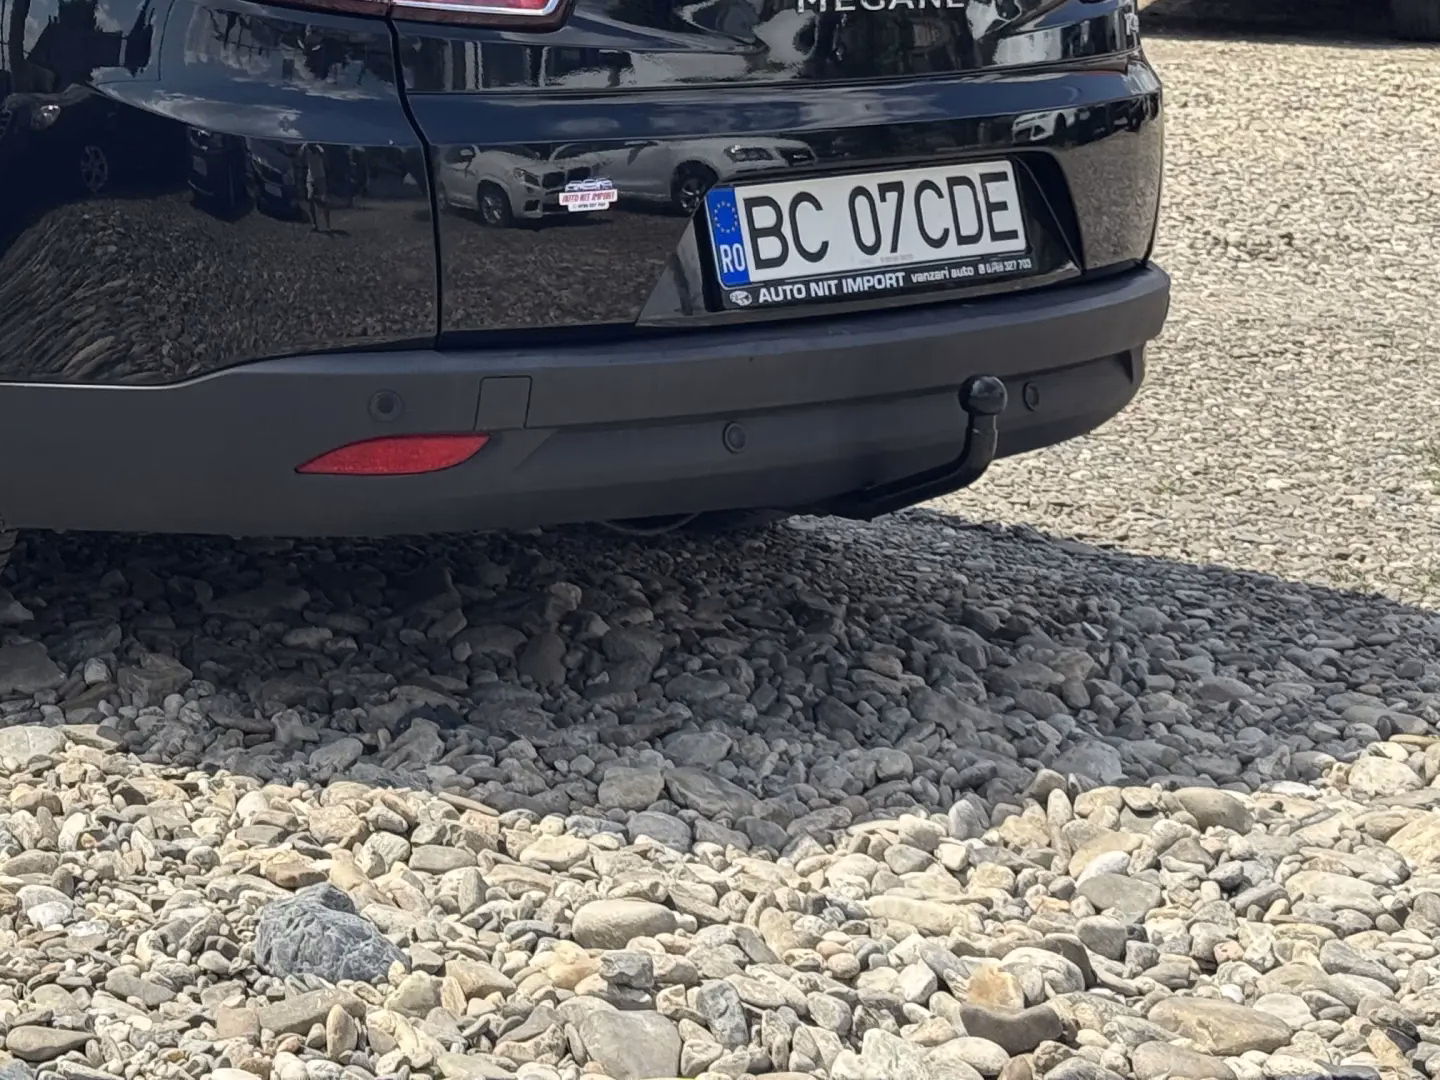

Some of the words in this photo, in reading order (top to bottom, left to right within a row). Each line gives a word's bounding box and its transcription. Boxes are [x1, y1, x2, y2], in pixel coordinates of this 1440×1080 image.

[742, 190, 829, 271] BC
[720, 243, 745, 273] RO
[759, 283, 806, 303] AUTO
[810, 278, 839, 297] NIT
[842, 272, 906, 293] IMPORT
[911, 267, 949, 283] vanzari
[951, 266, 975, 278] auto
